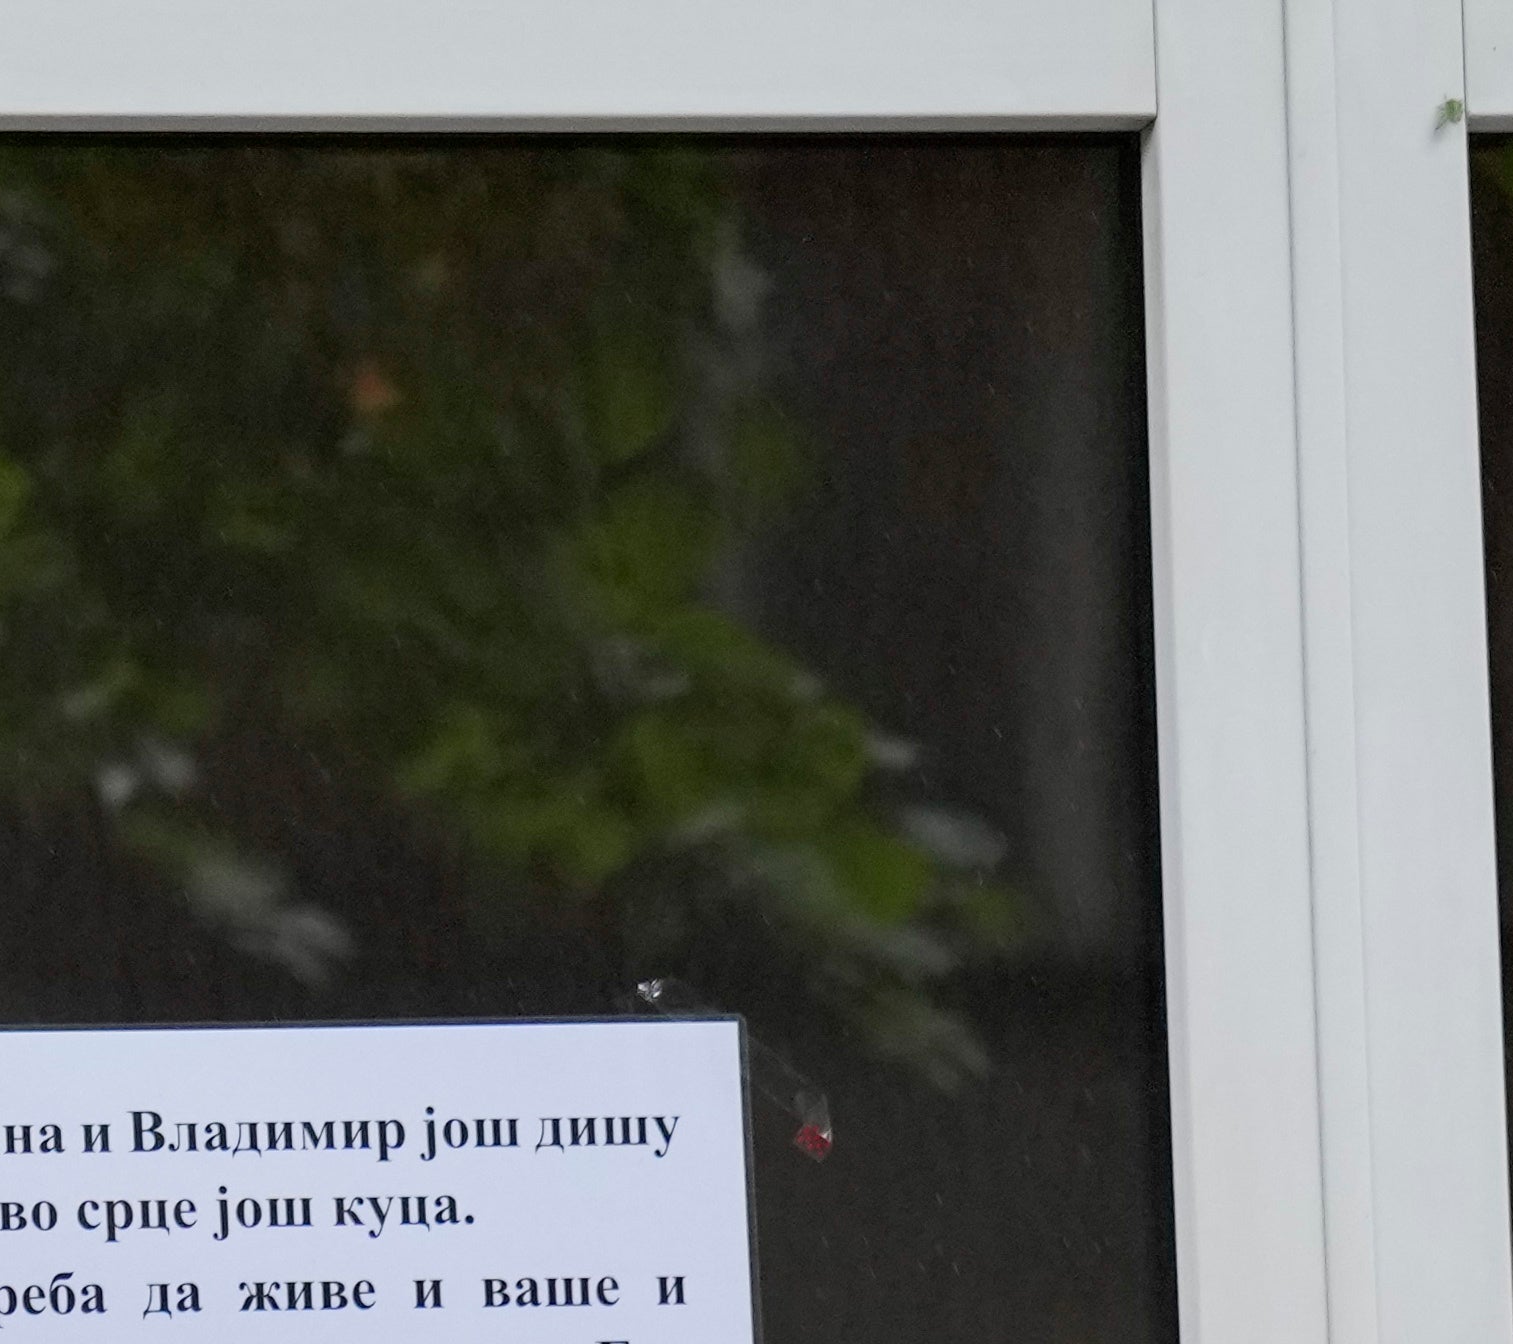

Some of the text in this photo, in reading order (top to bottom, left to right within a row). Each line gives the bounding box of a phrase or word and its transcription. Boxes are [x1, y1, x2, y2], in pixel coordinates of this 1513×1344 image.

[81, 1124, 111, 1153] и
[129, 1110, 405, 1162] Владимир
[419, 1105, 518, 1162] још
[535, 1115, 679, 1159] дишу
[77, 1198, 196, 1243] срце
[212, 1185, 312, 1241] још
[333, 1195, 474, 1239] куца.
[143, 1282, 202, 1319] да
[238, 1279, 375, 1312] живе
[413, 1279, 442, 1309] и
[483, 1276, 619, 1308] ваше
[657, 1276, 685, 1306] и
